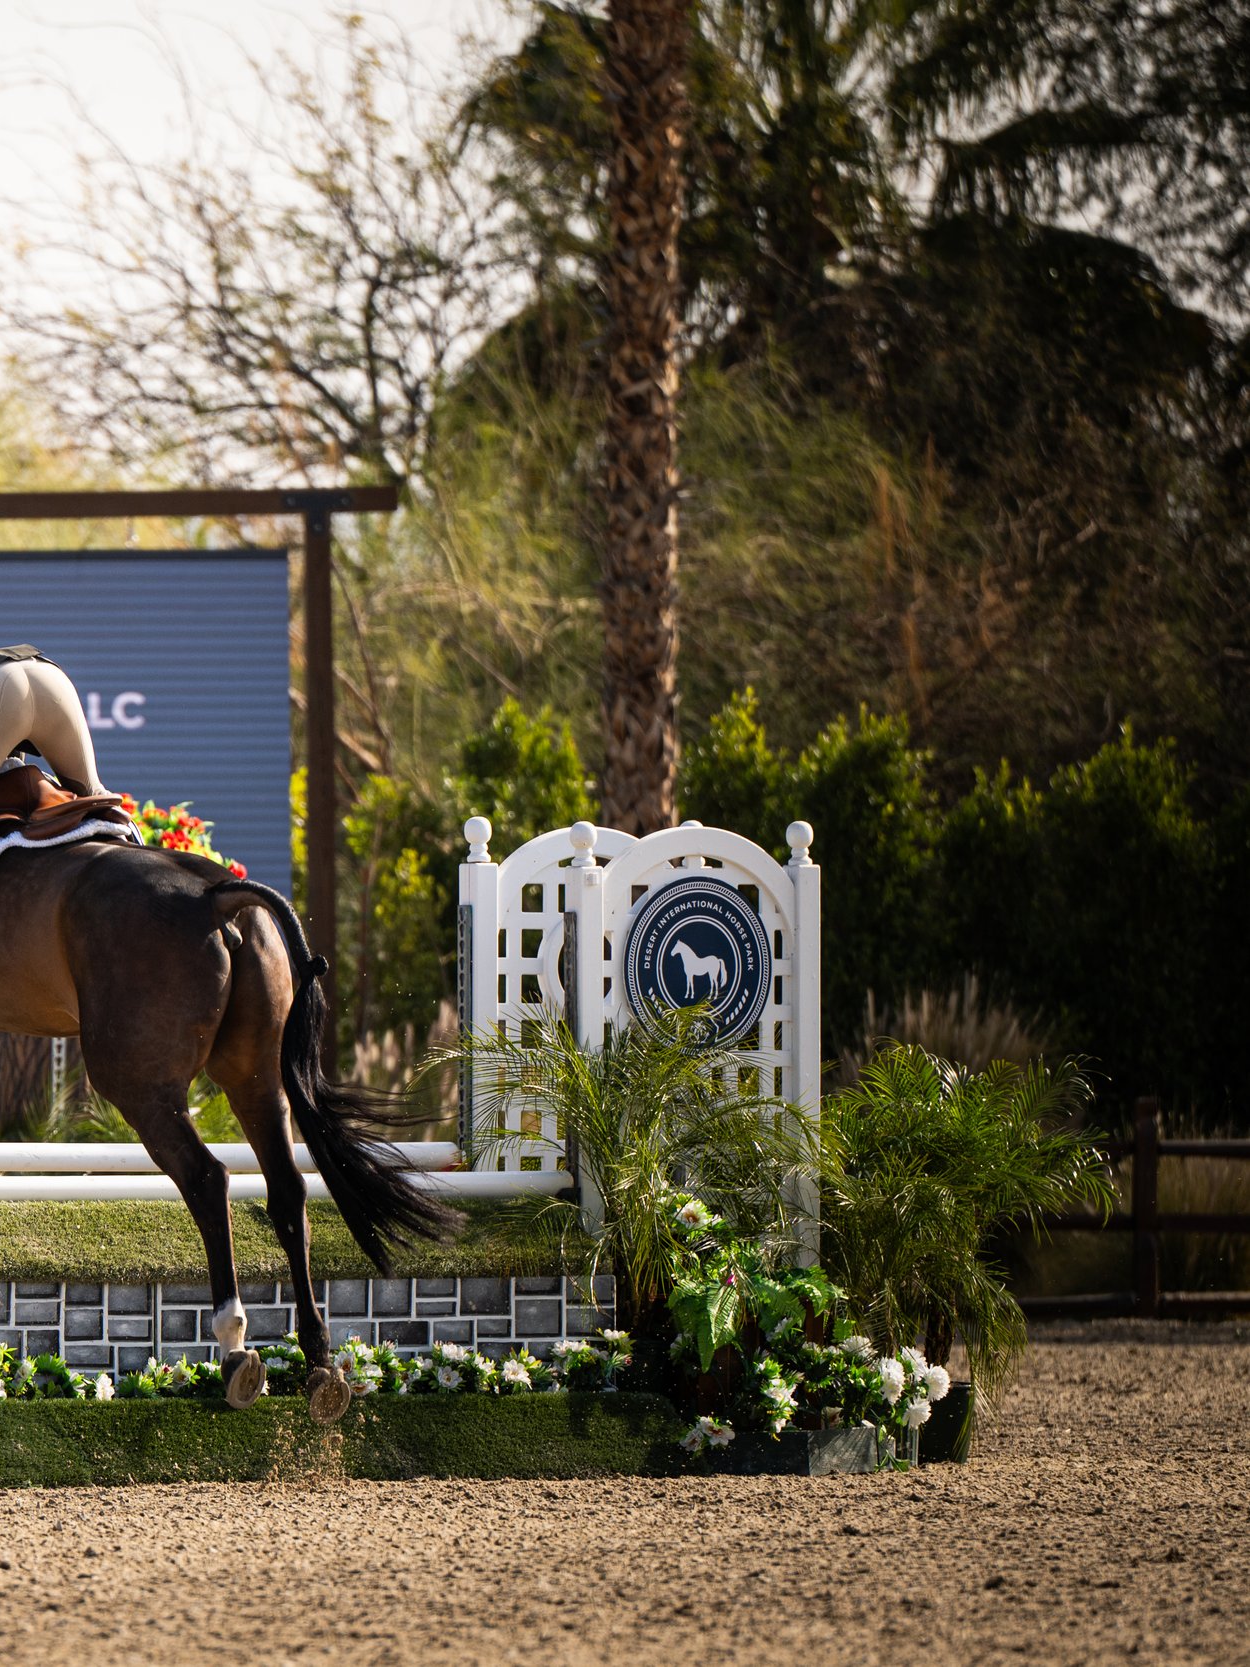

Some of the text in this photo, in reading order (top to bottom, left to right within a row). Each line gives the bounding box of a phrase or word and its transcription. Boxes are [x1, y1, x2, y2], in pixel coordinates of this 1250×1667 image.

[644, 900, 754, 971] DESERT INTERNATIONAL HORSE PARK
